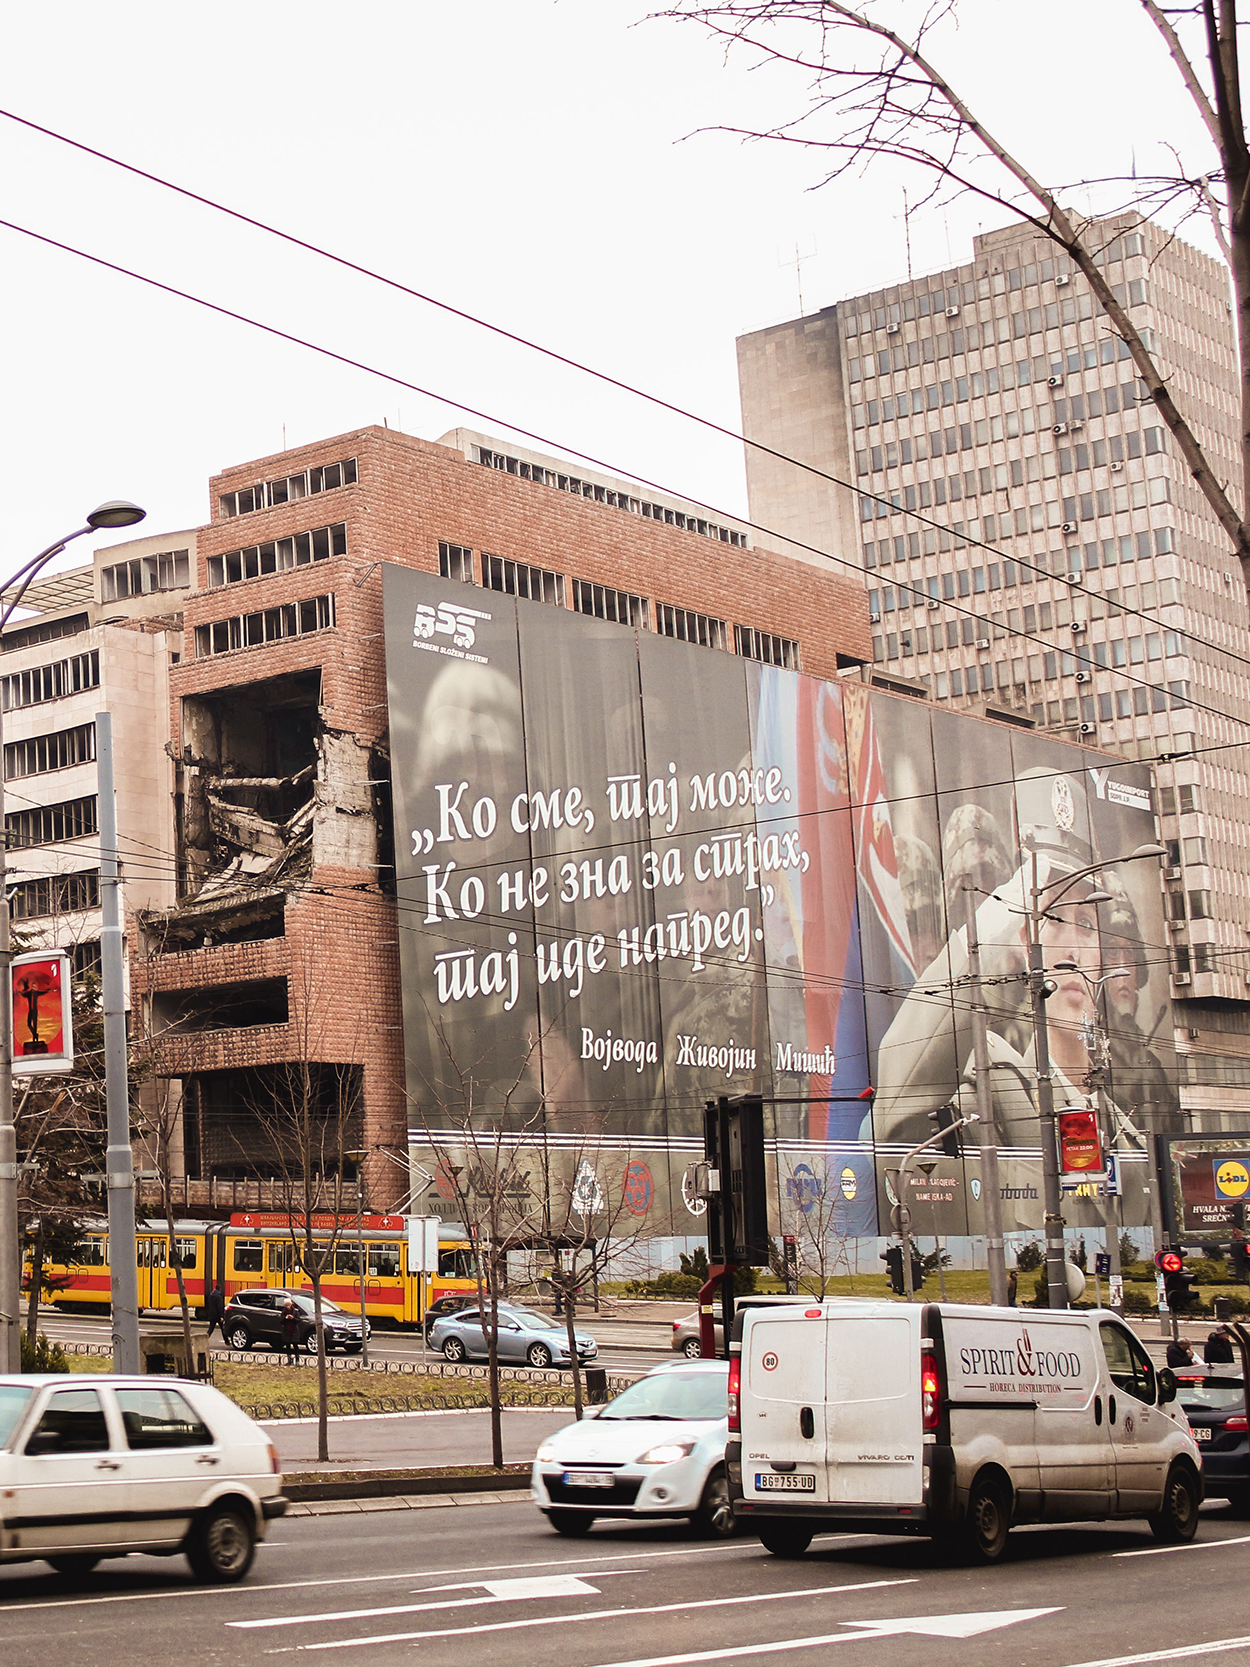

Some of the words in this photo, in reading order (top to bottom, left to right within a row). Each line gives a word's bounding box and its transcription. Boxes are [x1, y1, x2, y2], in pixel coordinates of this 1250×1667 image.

[412, 640, 440, 653] BORBENI
[440, 647, 465, 659] SLOŽENI
[465, 653, 489, 665] SISTEMI
[509, 786, 595, 835] сме,
[689, 763, 792, 813] може.
[1107, 780, 1150, 799] YUGOIMPORT
[421, 861, 486, 926] Ко
[496, 865, 550, 916] не
[559, 852, 632, 904] зна
[641, 847, 685, 891] за
[535, 932, 607, 999] иде
[579, 1027, 659, 1075] Војвода
[675, 1033, 758, 1079] Живојин
[775, 1041, 837, 1076] Мишић
[910, 1177, 928, 1186] MILAN
[1192, 1204, 1219, 1214] HVALA
[765, 1357, 775, 1366] 80
[960, 1347, 1016, 1376] SPIRIT
[1035, 1351, 1081, 1378] FOOD
[989, 1382, 1016, 1393] HORECA
[1018, 1383, 1062, 1394] DISTRIBUTION
